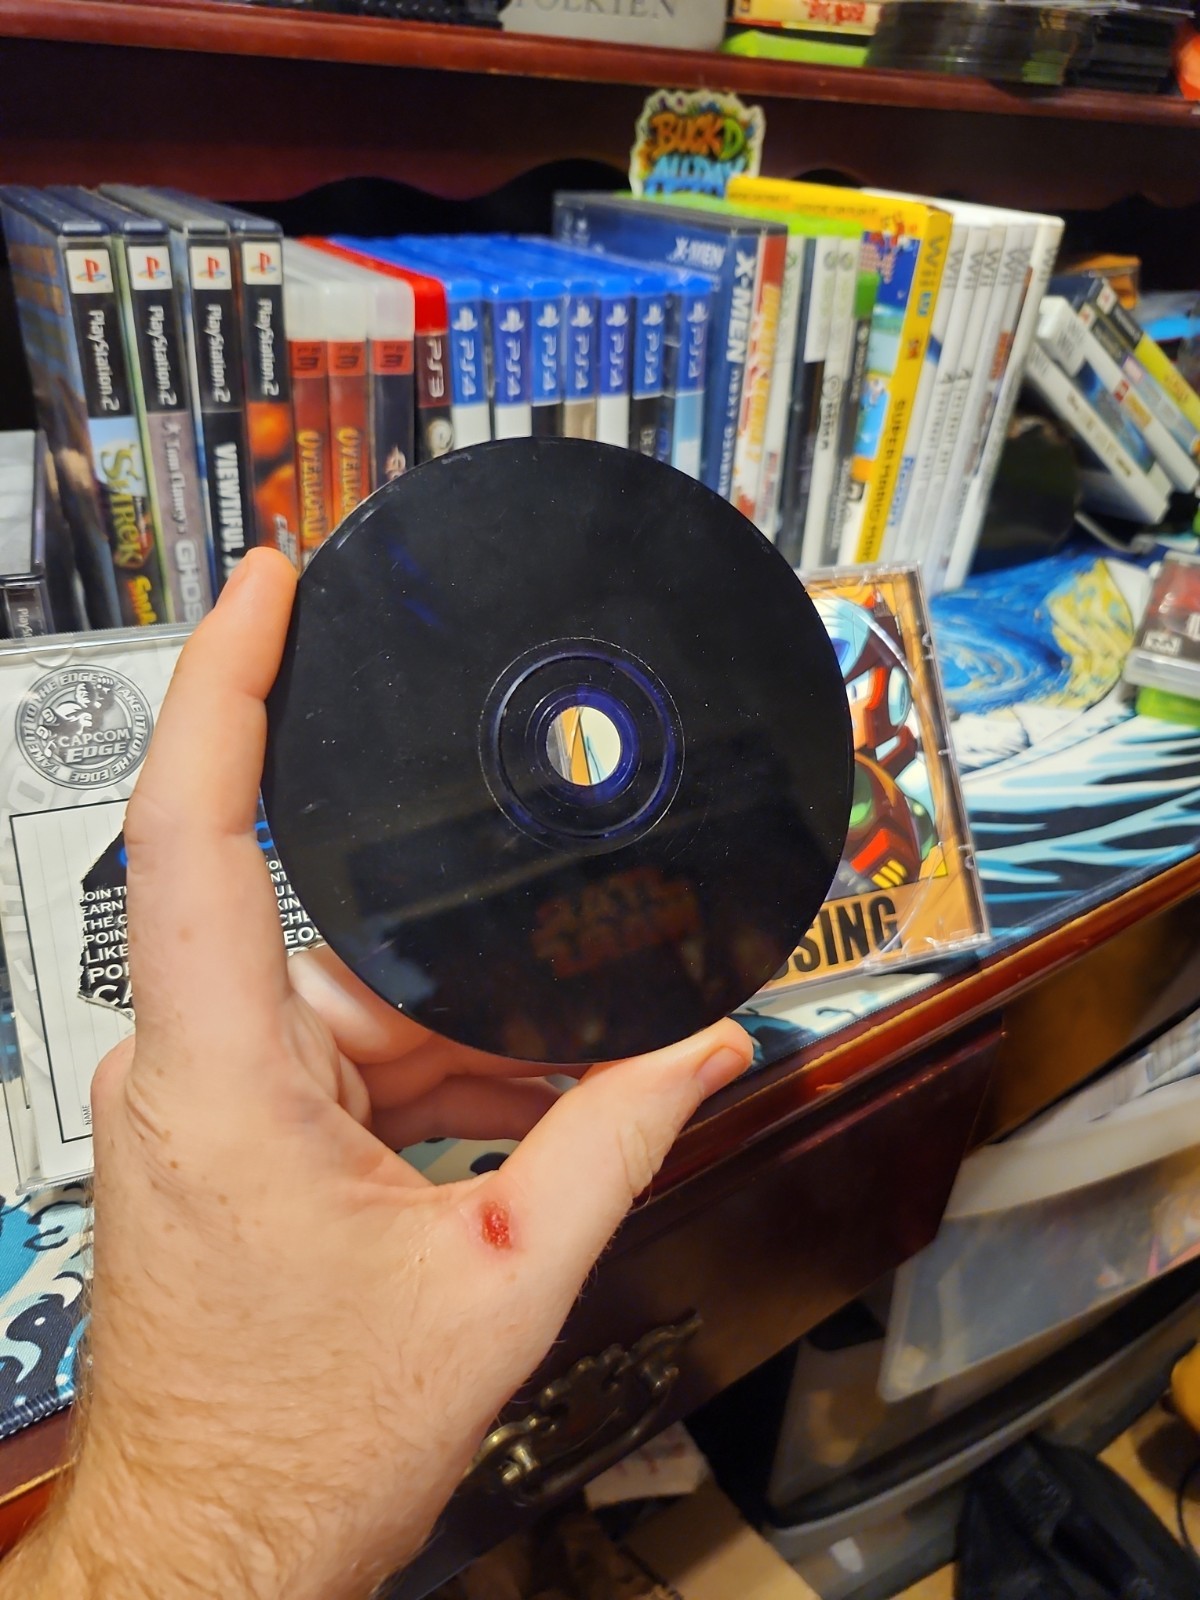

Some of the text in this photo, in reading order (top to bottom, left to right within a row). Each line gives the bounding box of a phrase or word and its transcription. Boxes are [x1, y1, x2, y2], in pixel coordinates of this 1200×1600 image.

[726, 250, 757, 364] X-MEN
[427, 338, 445, 398] PS3
[214, 441, 245, 552] VIEWTIFUL
[175, 539, 204, 624] GHOS
[59, 672, 98, 686] EDGE
[114, 681, 143, 712] TAKE
[58, 727, 132, 748] CAPCOM
[65, 741, 128, 764] EDGE
[70, 769, 110, 784] EDGE
[83, 915, 115, 931] THE
[83, 928, 128, 947] POIN
[773, 895, 904, 982] SING
